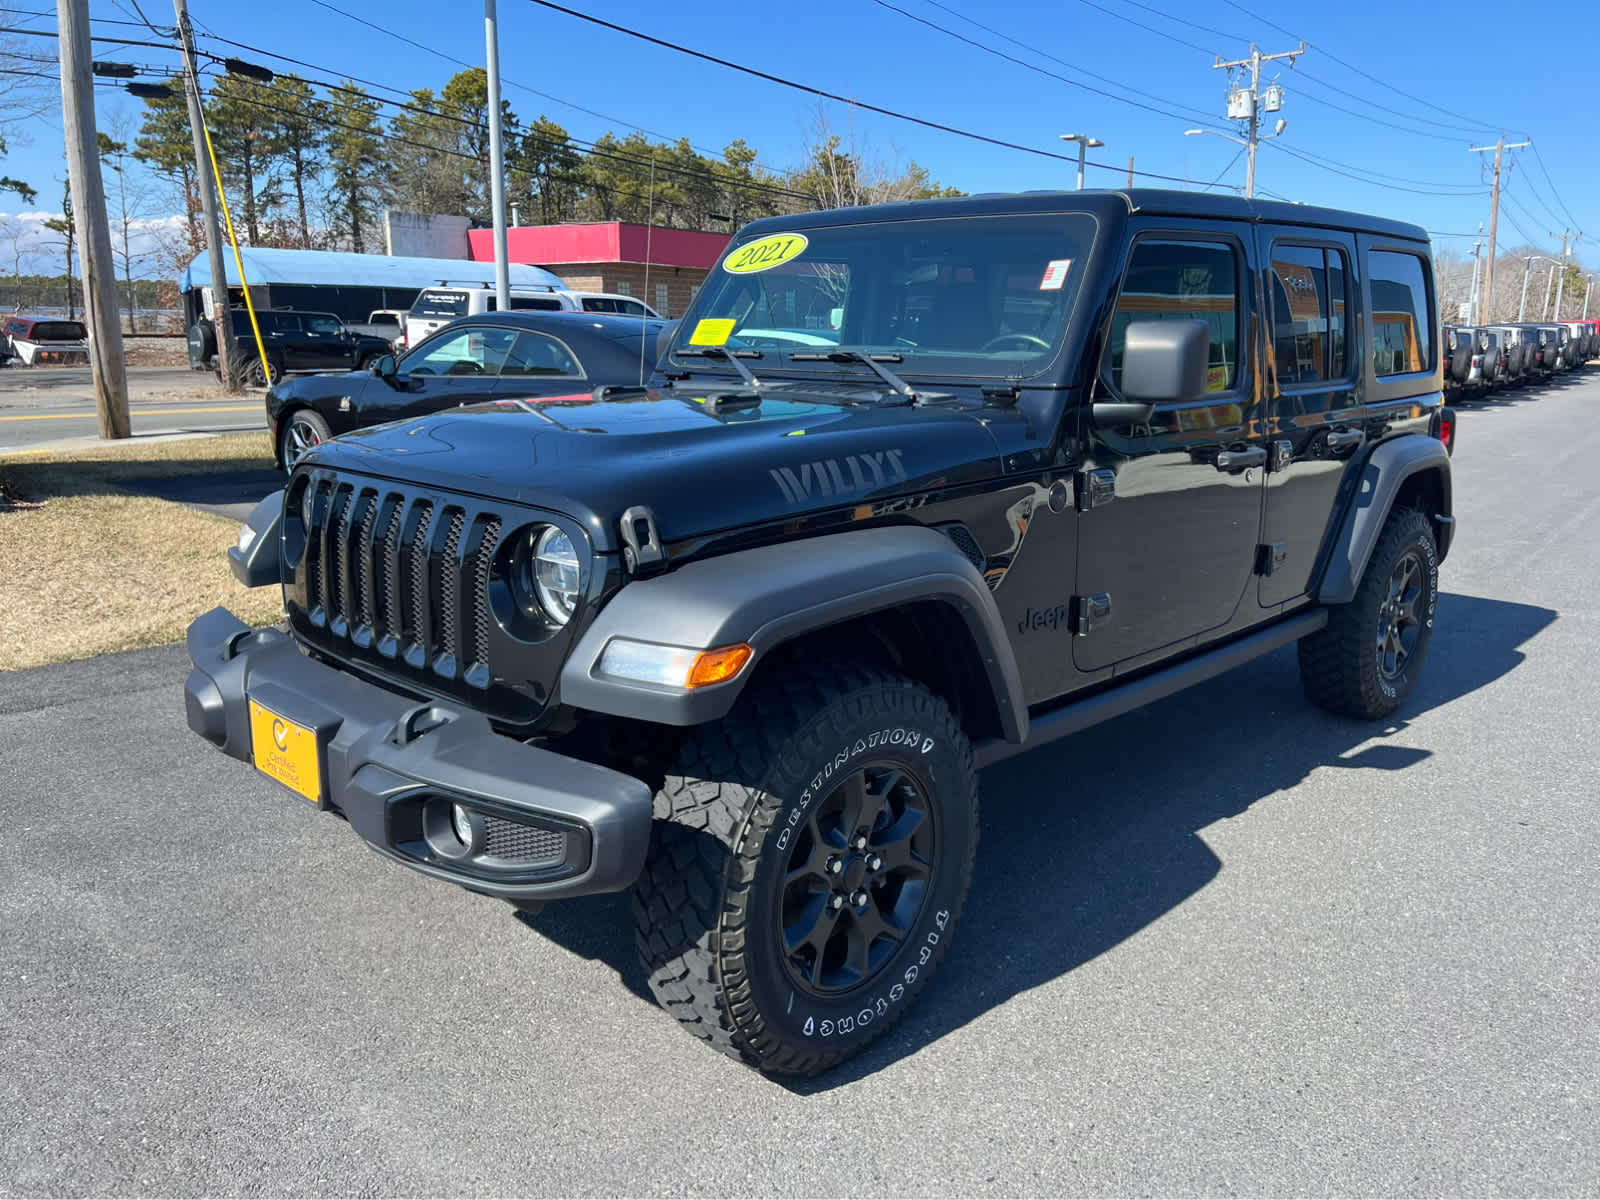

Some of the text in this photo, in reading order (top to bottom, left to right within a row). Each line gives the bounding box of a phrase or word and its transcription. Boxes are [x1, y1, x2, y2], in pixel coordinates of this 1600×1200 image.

[735, 239, 795, 268] 2021
[768, 449, 907, 504] WILLYS
[1018, 605, 1066, 634] Jeep
[776, 729, 920, 850] DESTINATION
